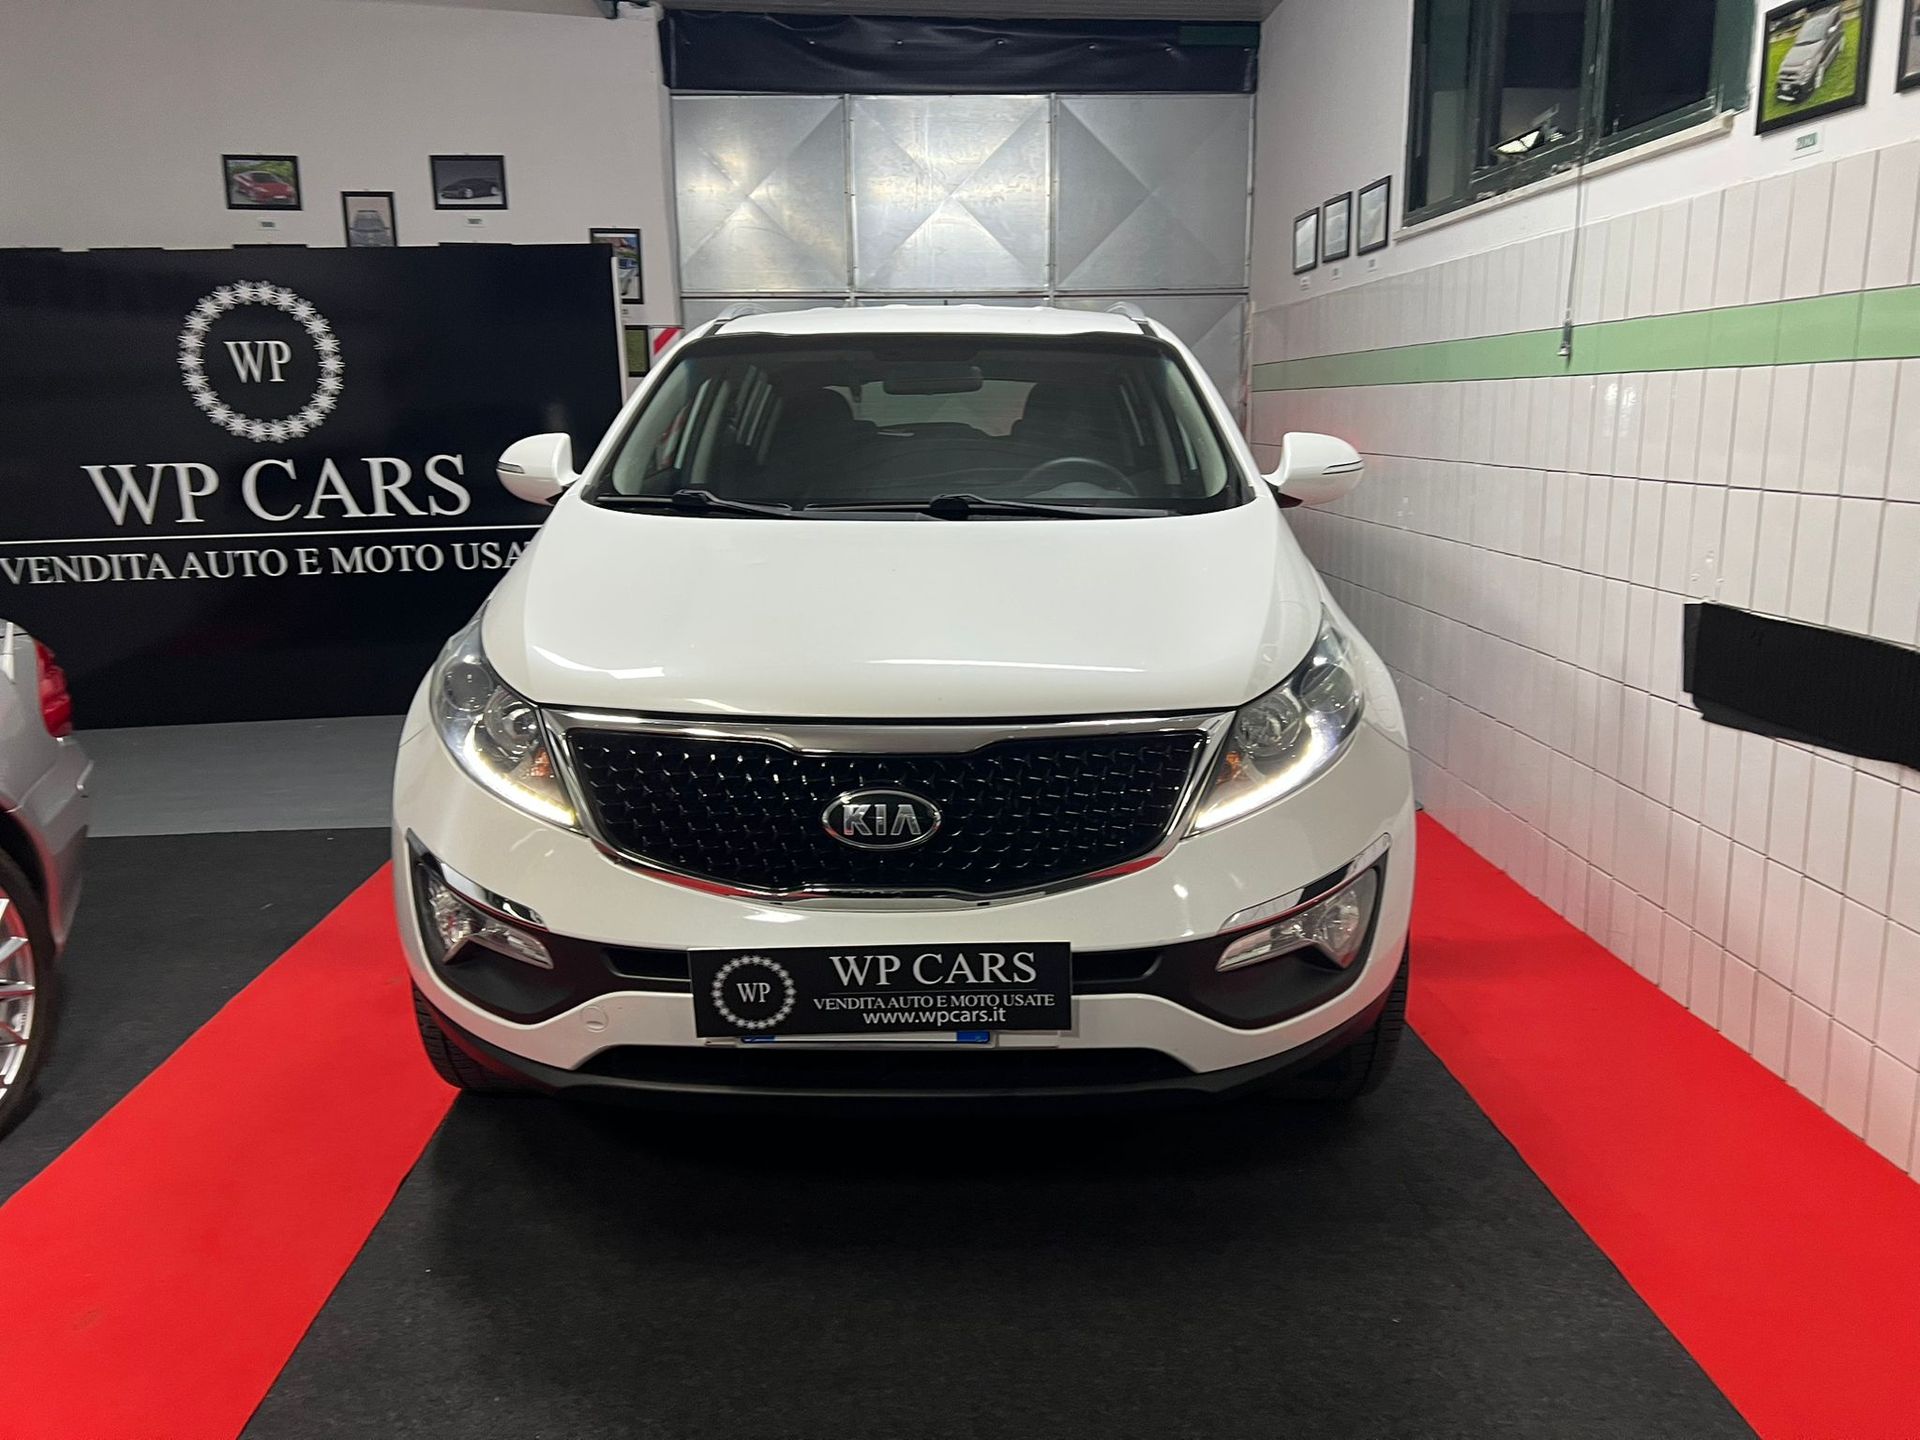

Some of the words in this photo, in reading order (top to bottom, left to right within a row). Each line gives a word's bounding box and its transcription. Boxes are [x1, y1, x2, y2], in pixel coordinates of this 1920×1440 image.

[223, 340, 292, 383] WP
[81, 462, 220, 526] WP
[241, 454, 471, 522] CARS
[0, 553, 177, 585] VENDITA
[179, 549, 289, 579] AUTO
[295, 548, 323, 575] E
[328, 544, 446, 574] MOTO
[451, 541, 532, 570] USA
[842, 803, 922, 836] KIA
[828, 954, 901, 986] WP
[912, 951, 1037, 985] CARS
[736, 982, 771, 1003] WP
[813, 997, 886, 1011] VENDITA
[887, 995, 934, 1009] AUTO
[936, 995, 948, 1008] E
[950, 994, 1000, 1008] MOTO
[1003, 994, 1056, 1007] USATE
[862, 1006, 1007, 1027] www.wpcars.it
